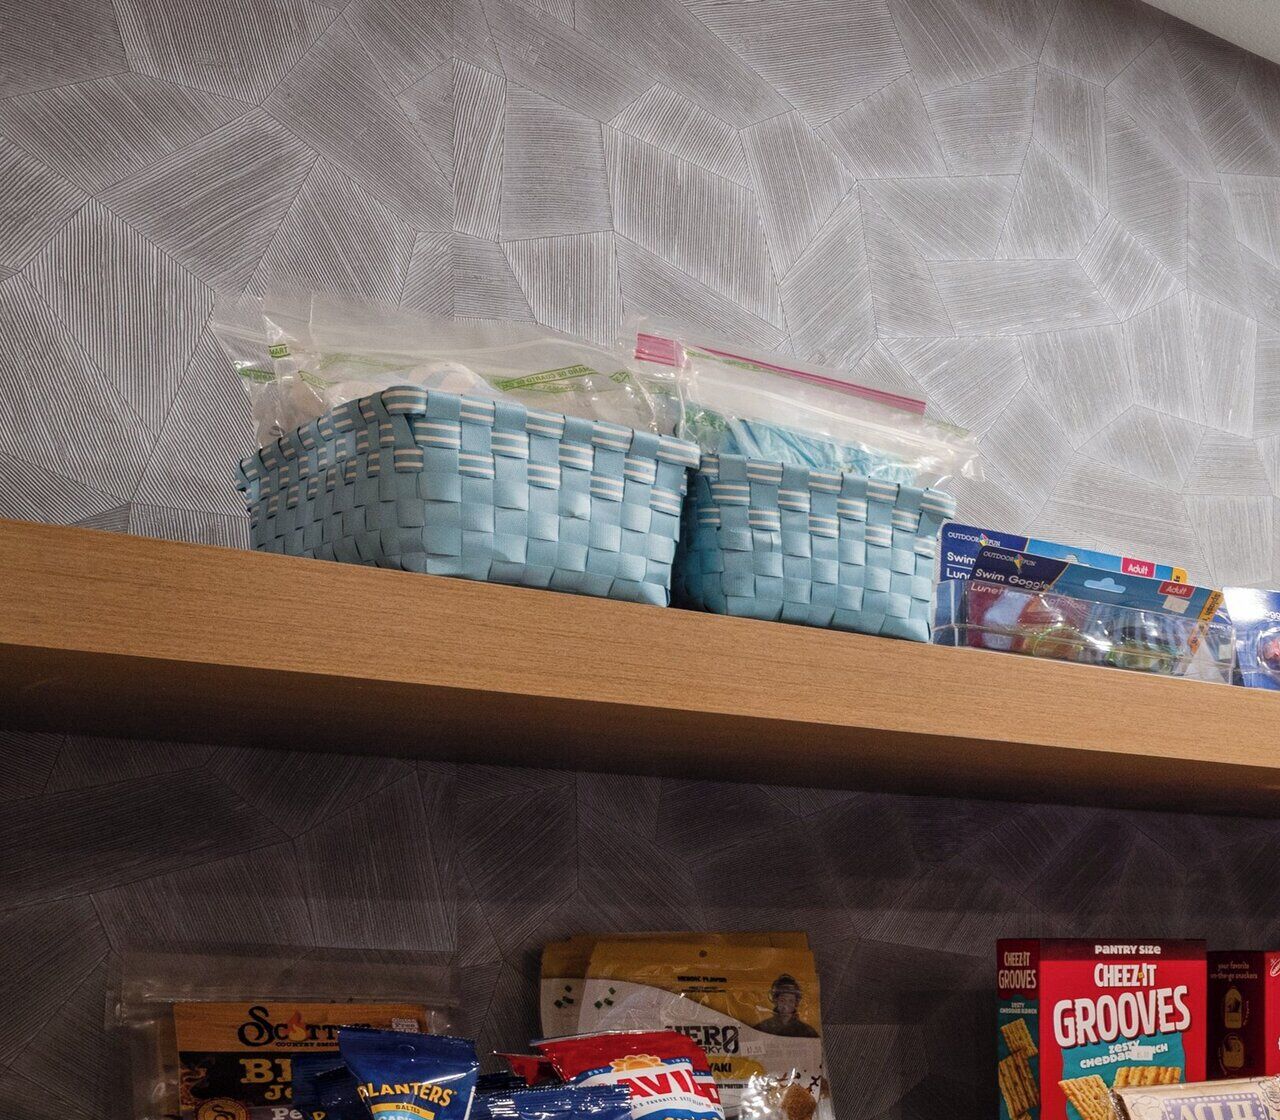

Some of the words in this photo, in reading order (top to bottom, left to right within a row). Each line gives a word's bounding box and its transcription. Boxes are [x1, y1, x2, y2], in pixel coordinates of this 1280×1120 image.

[948, 531, 979, 543] OUTDOOR
[983, 551, 1014, 562] OUTDOOR
[975, 568, 1005, 582] Swim
[1127, 564, 1148, 574] Adult
[1165, 585, 1186, 595] Adult
[998, 970, 1037, 989] GROOVES
[1053, 986, 1191, 1047] GROOVES
[357, 1082, 453, 1108] PLANTERS
[395, 1103, 421, 1115] SALTED
[1227, 1100, 1258, 1120] II
